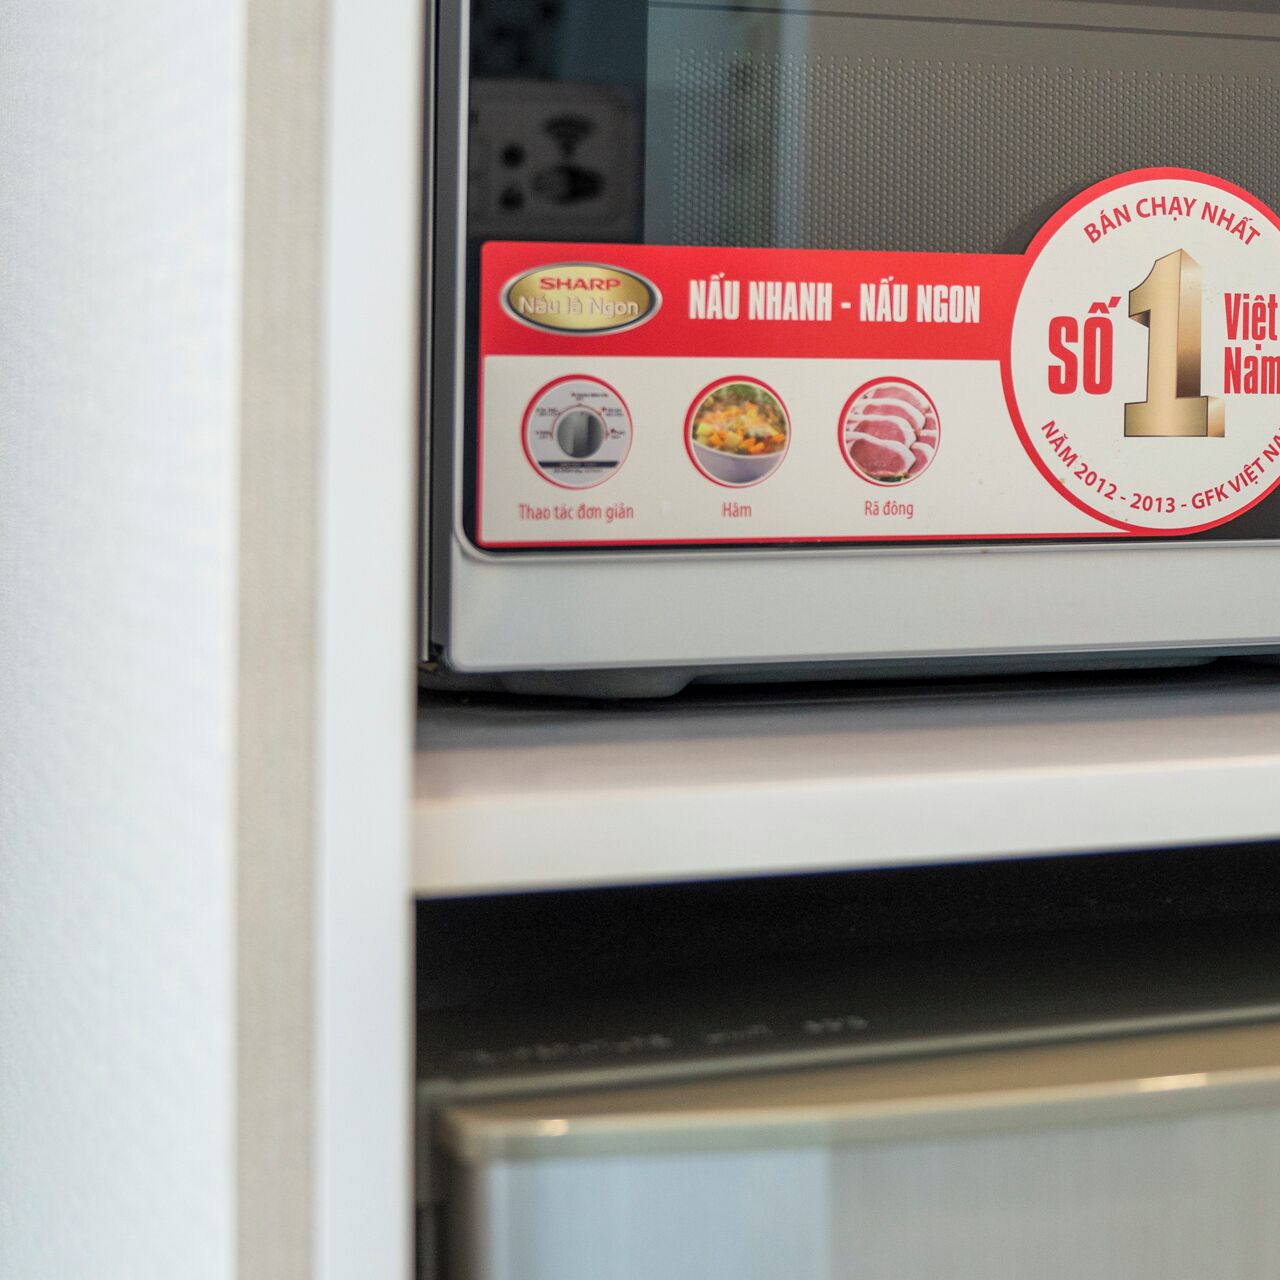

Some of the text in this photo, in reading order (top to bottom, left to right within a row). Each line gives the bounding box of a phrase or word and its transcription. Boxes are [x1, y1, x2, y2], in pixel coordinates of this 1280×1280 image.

[1083, 196, 1261, 246] BÁN CHẠY NHẤT
[540, 277, 621, 291] SHARP
[588, 297, 639, 319] Ngon
[689, 272, 740, 320] NẤU
[748, 281, 833, 321] NHANH
[860, 276, 908, 322] NẤU
[917, 284, 980, 323] NGON
[1124, 248, 1225, 437] 1
[1224, 293, 1278, 351] Việt
[1041, 420, 1079, 469] NĂM
[1074, 463, 1119, 501] 2012
[1130, 493, 1176, 514] 2013
[1191, 483, 1230, 510] GFK
[1229, 457, 1267, 493] VIỆT
[520, 502, 550, 520] Thao
[554, 502, 573, 520] tác
[577, 502, 602, 520] đơn
[864, 500, 914, 519] Rã đông
